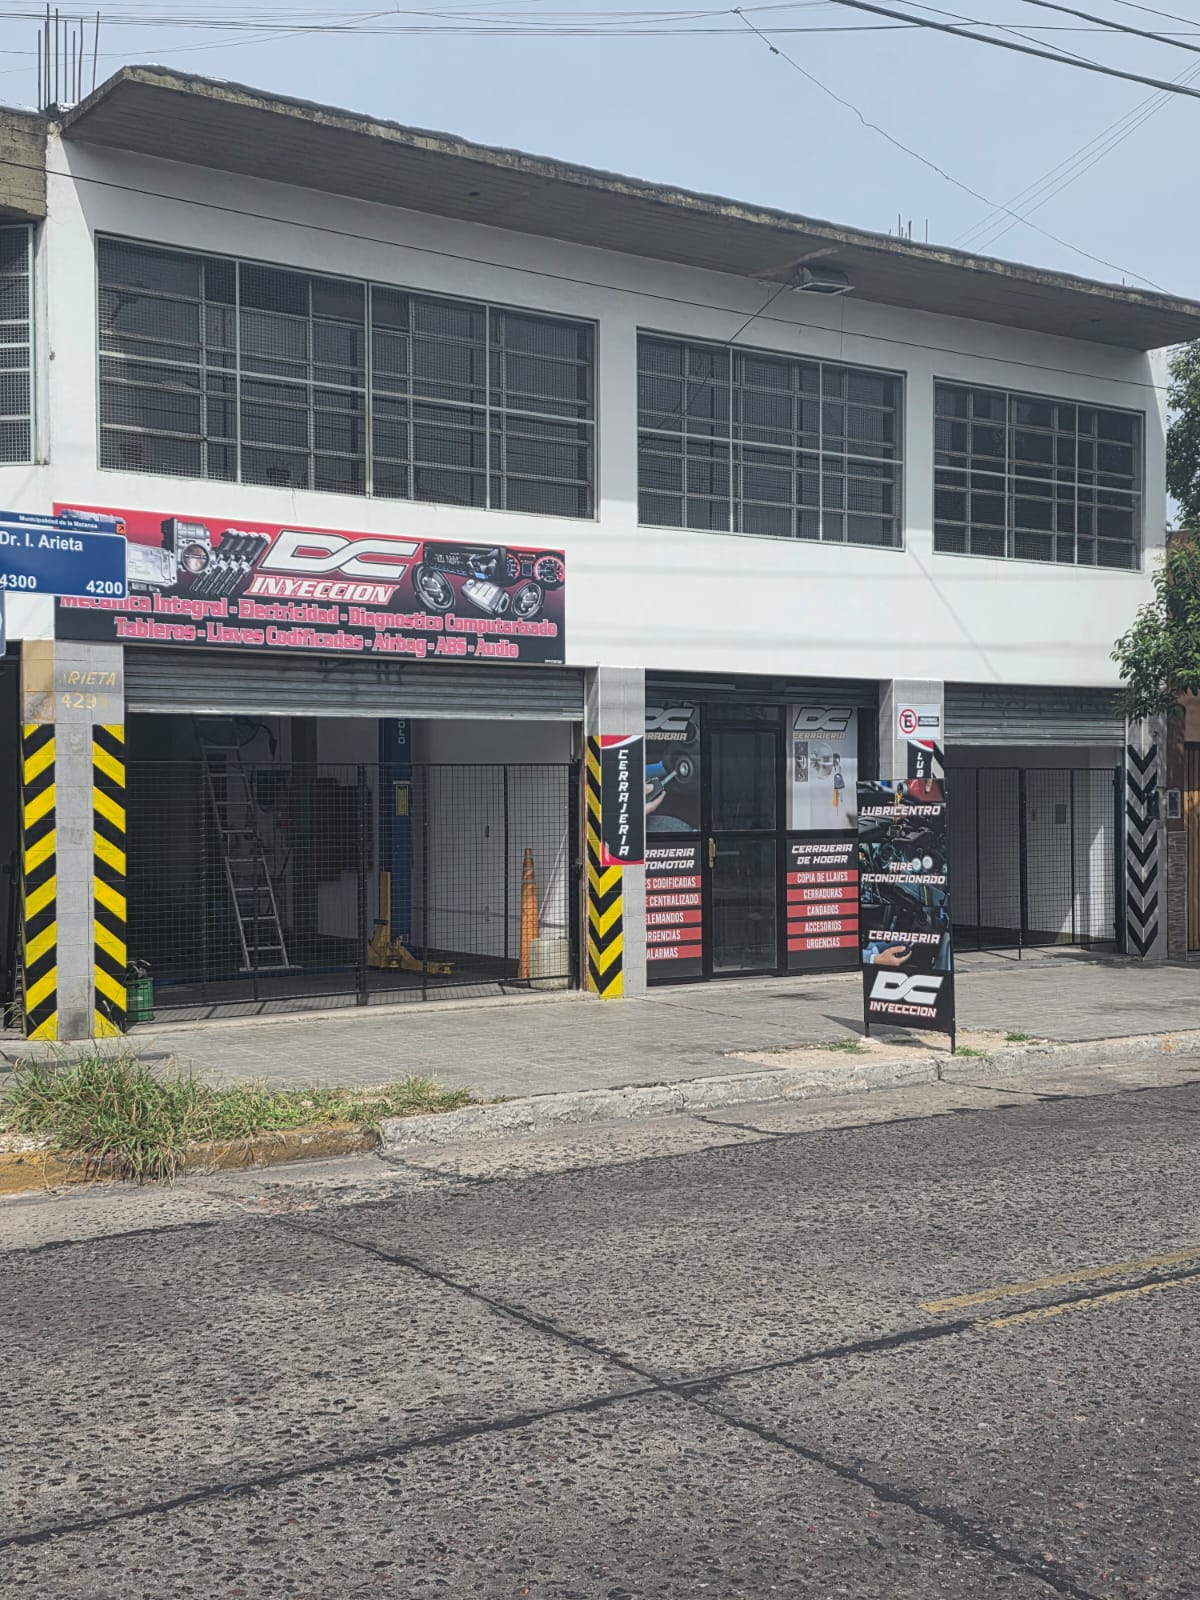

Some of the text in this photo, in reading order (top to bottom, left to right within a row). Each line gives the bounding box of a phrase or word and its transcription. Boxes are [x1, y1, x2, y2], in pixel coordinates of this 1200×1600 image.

[0, 531, 83, 551] Dr. I. Arieta
[257, 530, 422, 580] DC
[0, 574, 37, 589] 4300
[86, 580, 123, 594] 4200
[249, 576, 395, 603] INYECCION
[153, 593, 229, 620] Integral
[238, 598, 339, 624] Electricidad
[348, 606, 443, 631] Diagnostico
[445, 613, 558, 637] Computarizado
[114, 616, 196, 641] Tableros
[206, 622, 265, 645] Llaves
[266, 626, 363, 650] Codificadas
[372, 633, 427, 657] Airbag
[434, 636, 467, 655] ABS
[474, 638, 519, 658] Audio
[793, 707, 853, 731] DC
[618, 749, 630, 856] CERRAJERIA
[861, 805, 941, 816] LUBRICENTRO
[644, 848, 695, 858] RRAJERIA
[792, 844, 853, 854] CERRAJERIA
[645, 860, 695, 870] TOMOTOR
[797, 855, 848, 865] DE HOGAR
[889, 862, 913, 871] AIRE
[653, 876, 696, 889] CODIFICADAS
[797, 871, 848, 883] COPIA DE LLAVES
[861, 873, 945, 885] ACONDICIONADO
[803, 888, 842, 899] CERRADURAS
[649, 894, 699, 907] CENTRALIZADO
[807, 904, 839, 916] CANDADOS
[647, 912, 684, 924] LEMANDOS
[804, 921, 842, 933] ACCESORIOS
[806, 937, 840, 949] URGENCIAS
[868, 930, 941, 944] CERRAJERIA
[647, 947, 679, 959] ALARMAS
[869, 970, 944, 1005] DC
